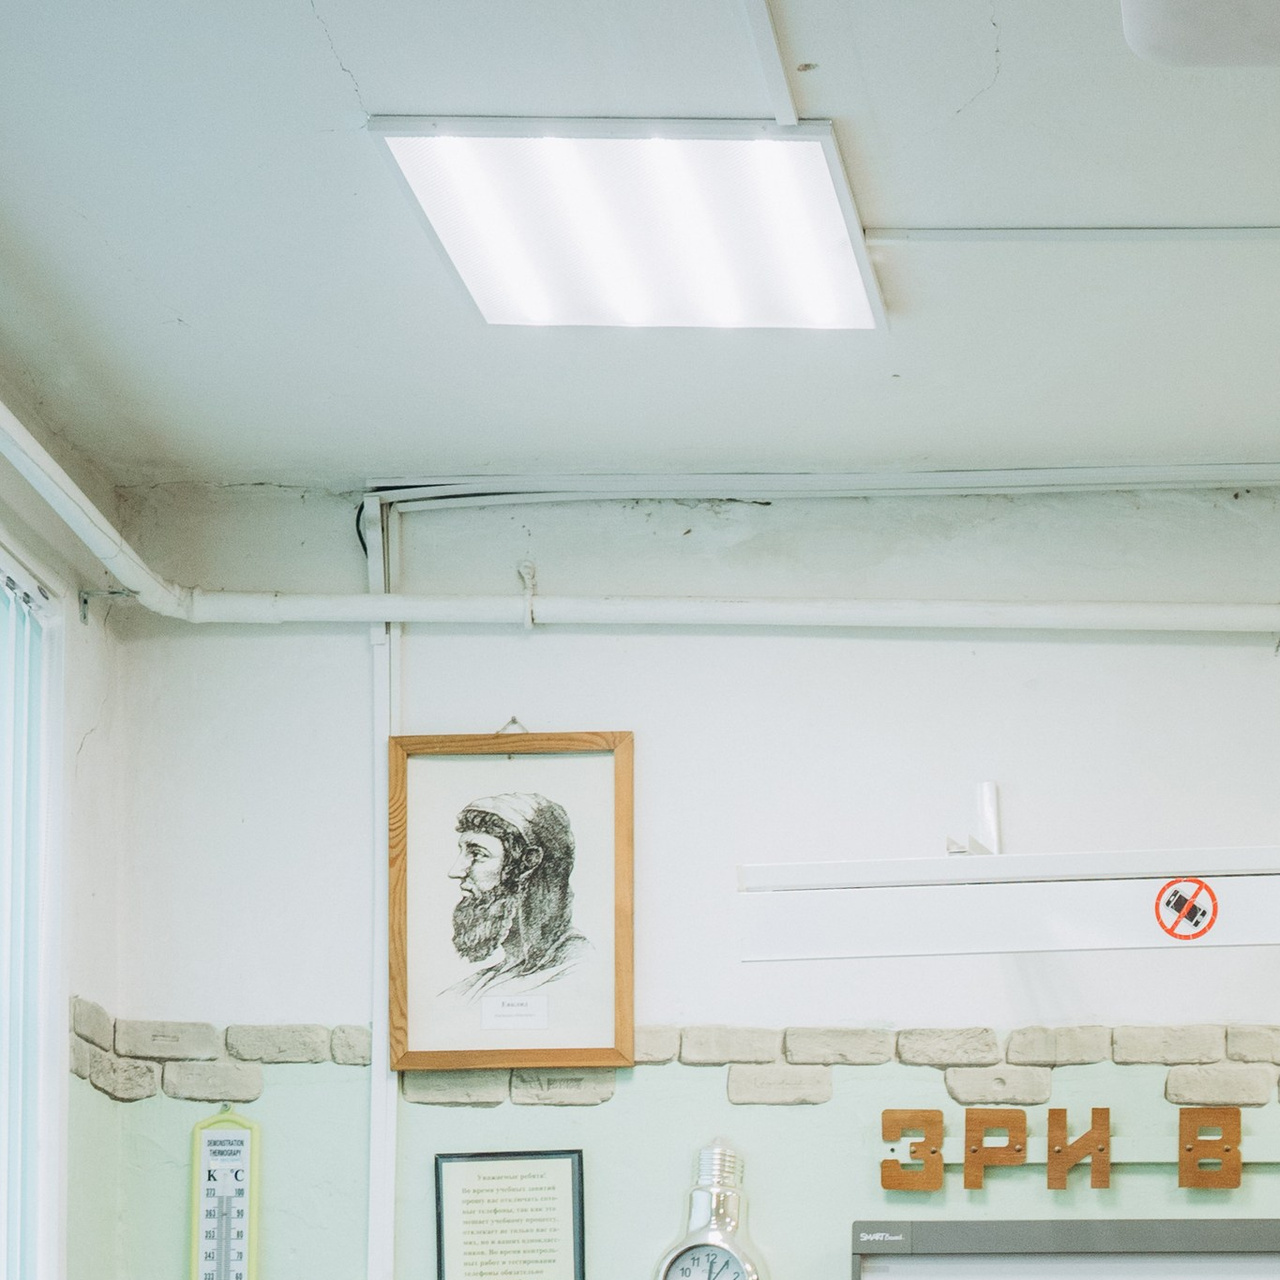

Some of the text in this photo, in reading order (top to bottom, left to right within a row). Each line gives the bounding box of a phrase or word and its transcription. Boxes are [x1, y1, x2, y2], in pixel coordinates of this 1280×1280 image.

[207, 1139, 244, 1147] DEMONSTRATION
[209, 1149, 242, 1157] THERMOGRAPY
[881, 1107, 1110, 1191] ЗРИ
[1178, 1106, 1243, 1190] В
[207, 1169, 218, 1182] K
[206, 1188, 245, 1197] 373 100
[205, 1209, 244, 1218] 363 90
[204, 1230, 244, 1239] 353 80
[204, 1252, 243, 1260] 343 70
[705, 1253, 718, 1264] 12
[690, 1256, 700, 1267] 11
[680, 1267, 692, 1278] 10
